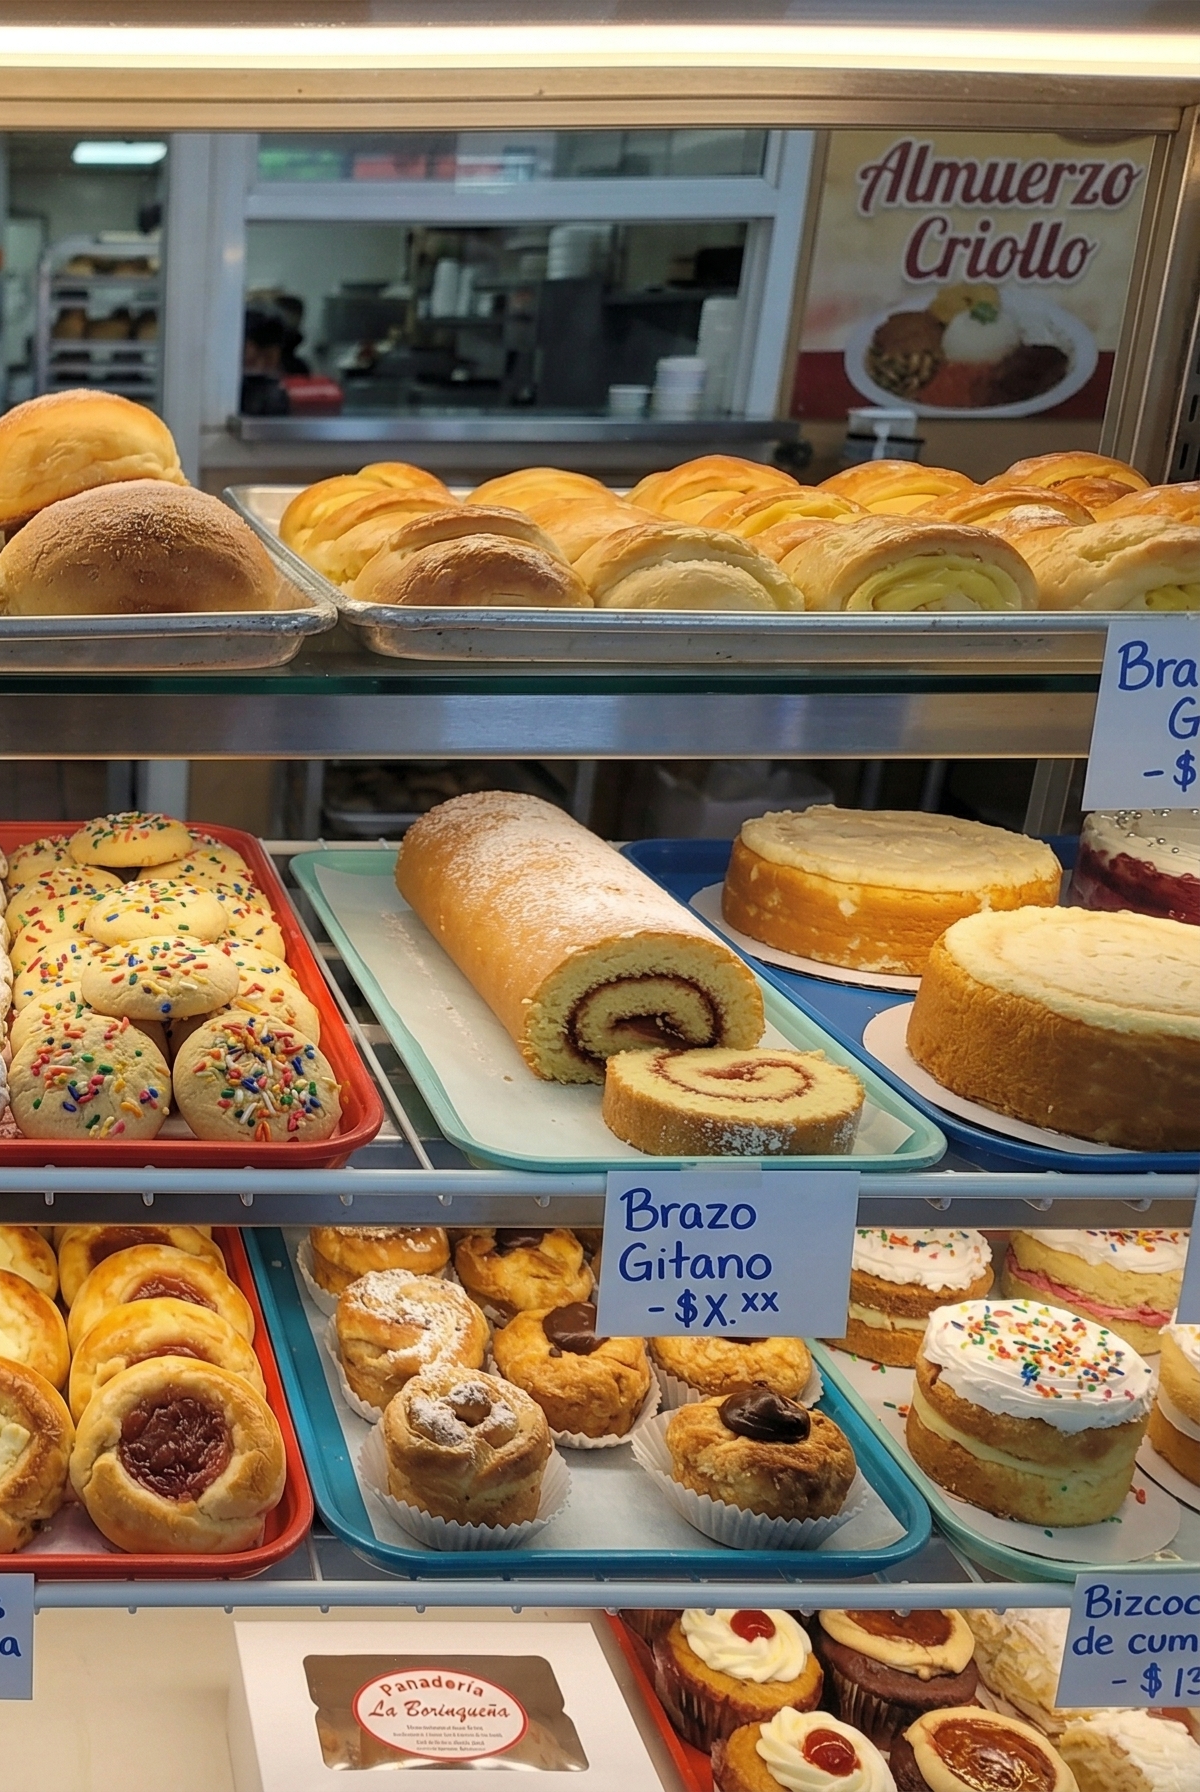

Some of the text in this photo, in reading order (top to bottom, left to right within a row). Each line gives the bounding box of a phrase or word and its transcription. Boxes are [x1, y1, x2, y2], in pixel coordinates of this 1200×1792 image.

[858, 140, 1143, 214] Almuerzo
[905, 216, 1097, 280] Criollo
[1117, 640, 1199, 692] Bra
[1168, 696, 1200, 740] G
[619, 1187, 757, 1233] Brazo
[618, 1240, 772, 1282] Gitano
[1084, 1584, 1200, 1619] Bizcoc
[1072, 1625, 1199, 1656] de cum
[368, 1699, 398, 1718] La
